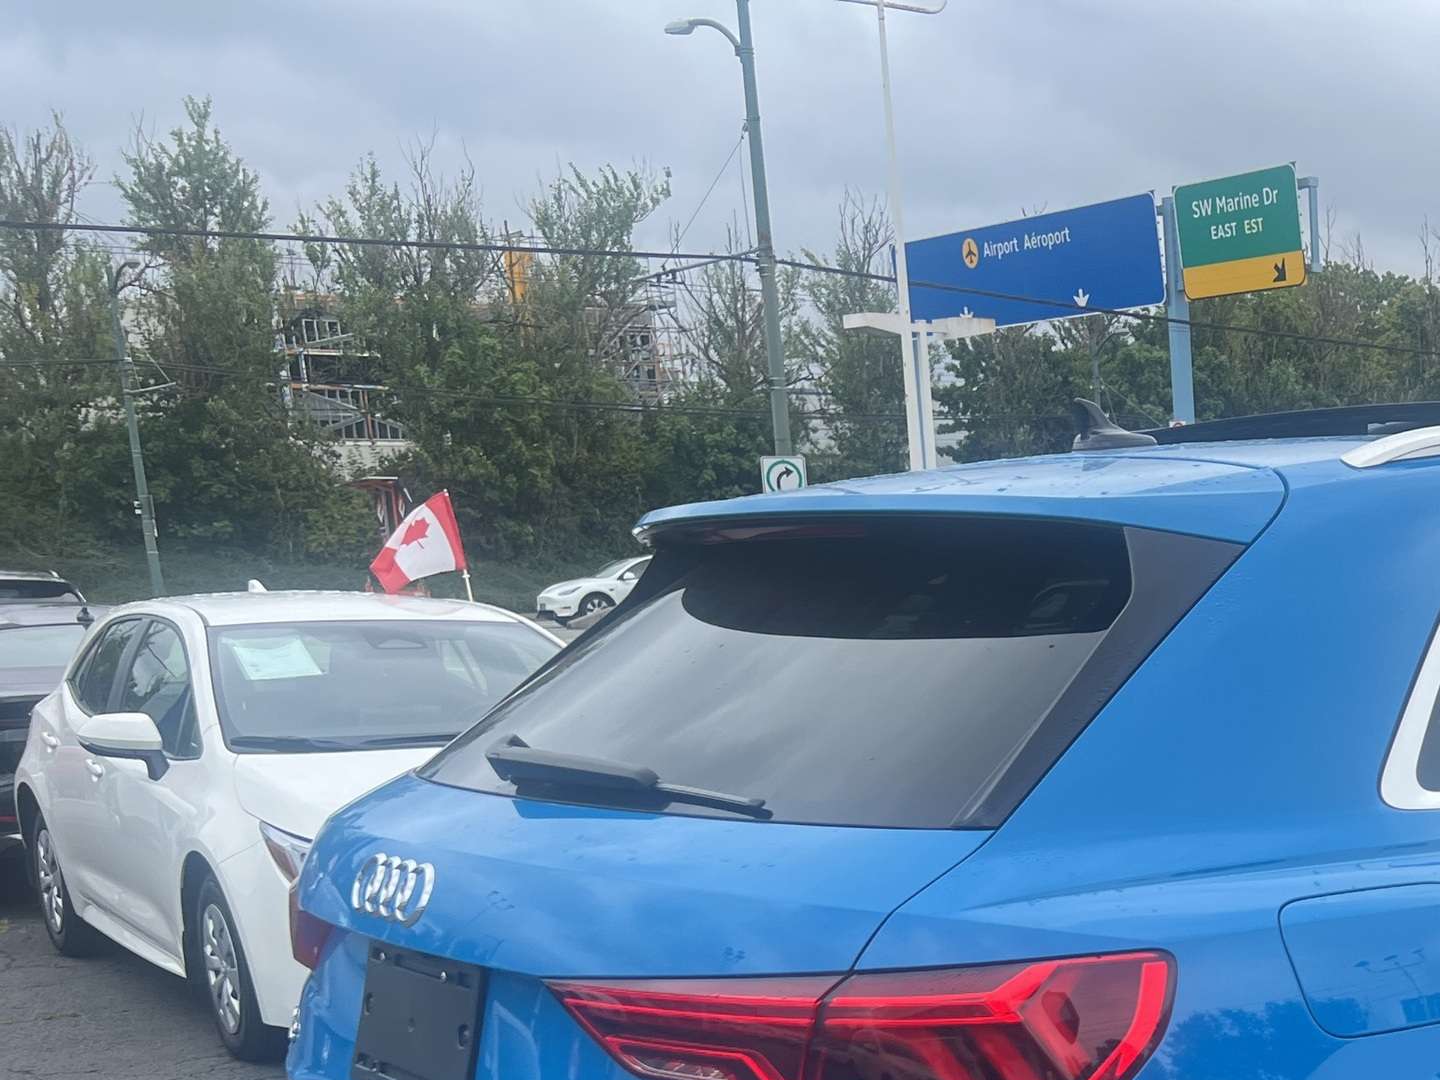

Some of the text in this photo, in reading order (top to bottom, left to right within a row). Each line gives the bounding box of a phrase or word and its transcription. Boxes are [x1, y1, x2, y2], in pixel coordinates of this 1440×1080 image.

[1192, 187, 1279, 218] SW Marine Dr
[984, 227, 1071, 260] Airport Aéroport
[1211, 217, 1263, 240] EAST EST
